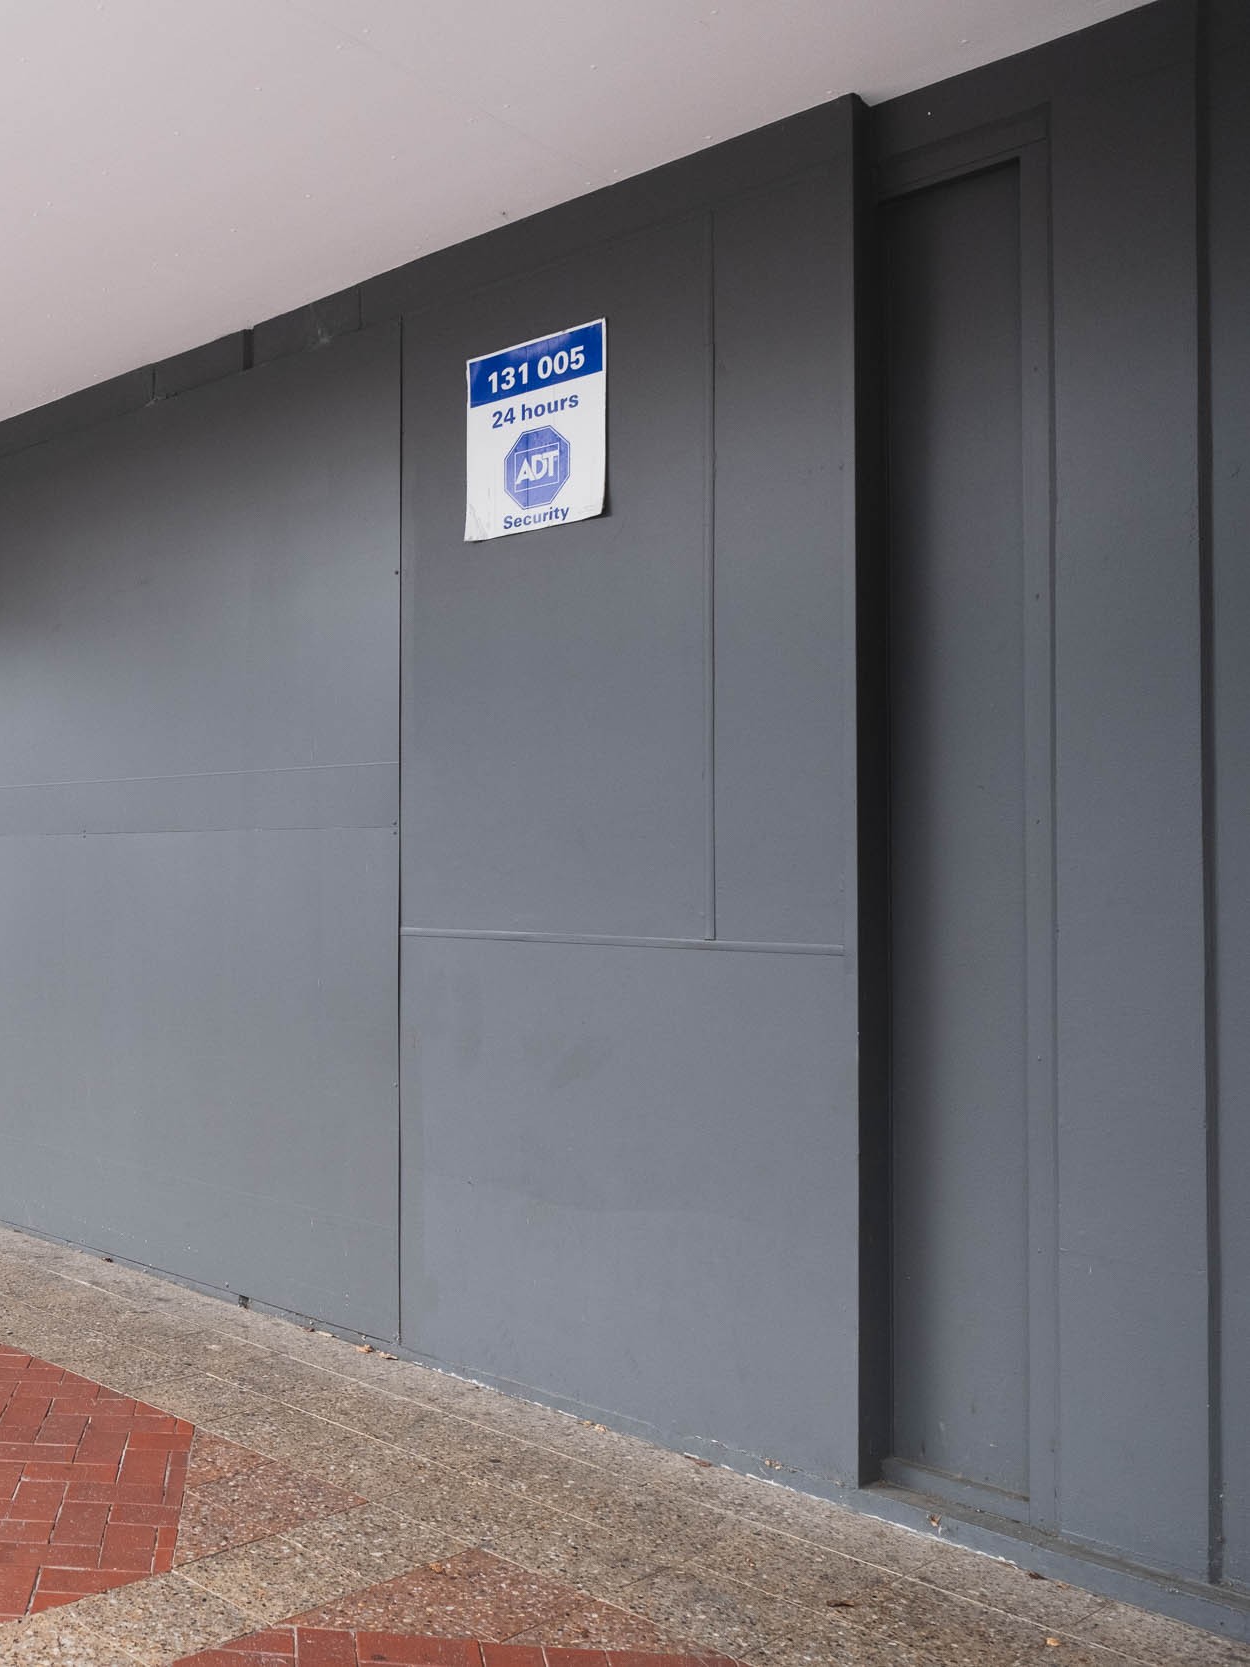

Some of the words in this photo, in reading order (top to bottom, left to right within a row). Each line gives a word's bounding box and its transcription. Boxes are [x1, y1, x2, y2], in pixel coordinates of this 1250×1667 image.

[488, 362, 528, 393] 131
[538, 345, 585, 379] 005
[492, 407, 516, 429] 24
[521, 394, 579, 421] hours
[515, 451, 559, 484] ADT
[503, 507, 570, 530] Security
